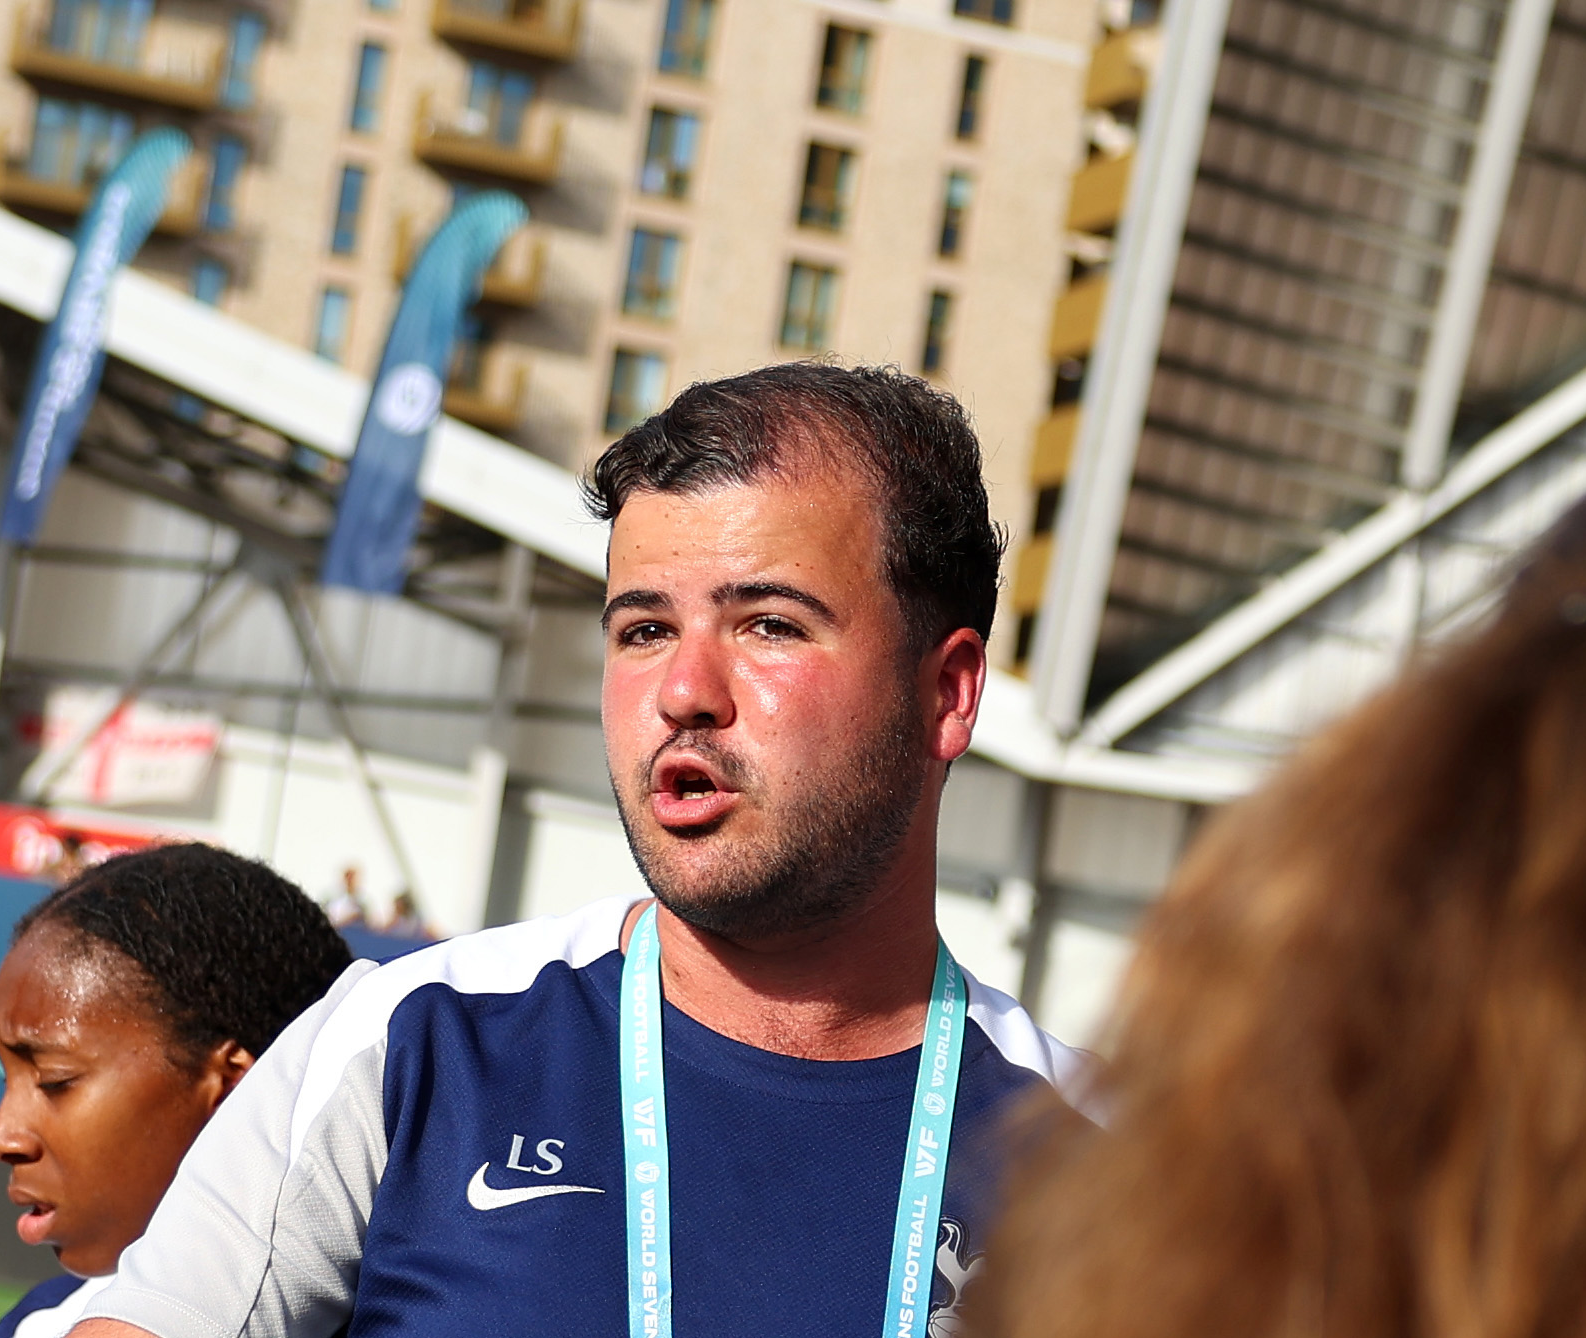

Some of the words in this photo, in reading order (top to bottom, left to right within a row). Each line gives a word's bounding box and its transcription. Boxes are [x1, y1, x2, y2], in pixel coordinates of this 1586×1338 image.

[633, 972, 649, 1083] FOOTBALL
[931, 1016, 952, 1088] WORLD
[506, 1133, 566, 1176] LS
[640, 1188, 656, 1267] WORLD
[901, 1194, 928, 1306] FOOTBALL
